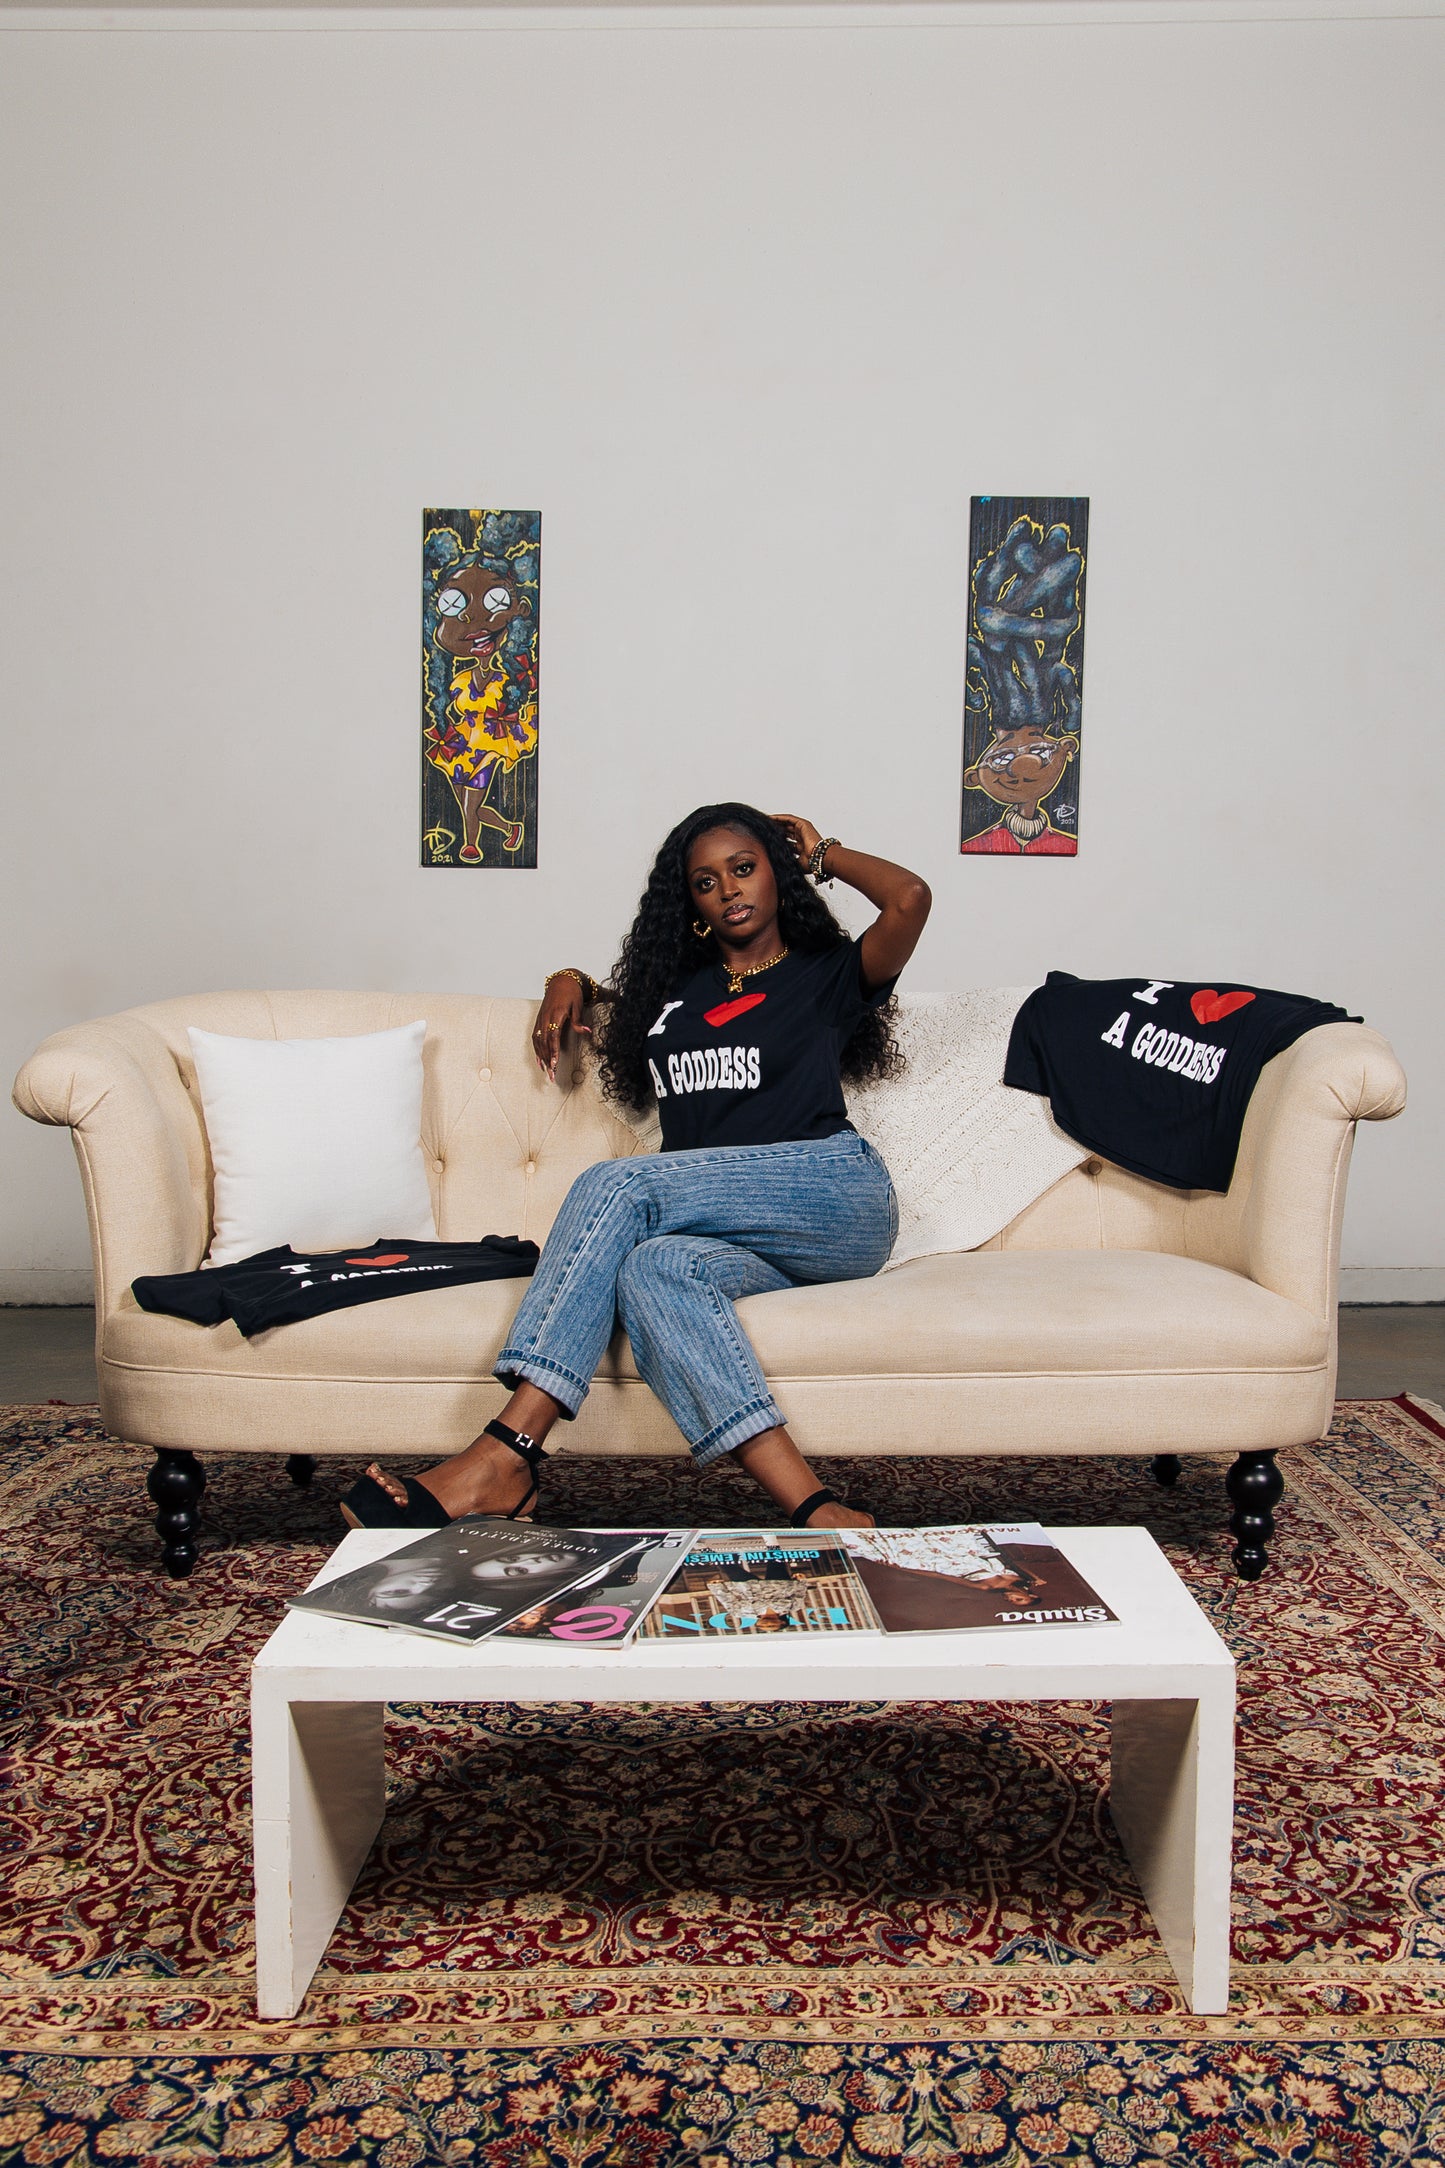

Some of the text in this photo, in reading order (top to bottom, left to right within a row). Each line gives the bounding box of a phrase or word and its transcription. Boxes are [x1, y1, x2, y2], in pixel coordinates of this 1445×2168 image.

[1132, 980, 1175, 1005] I
[647, 1000, 684, 1037] I
[1101, 1011, 1228, 1085] A GODDESS
[648, 1046, 761, 1099] A GODDESS
[422, 1603, 498, 1630] 21
[994, 1606, 1109, 1623] Shuba
